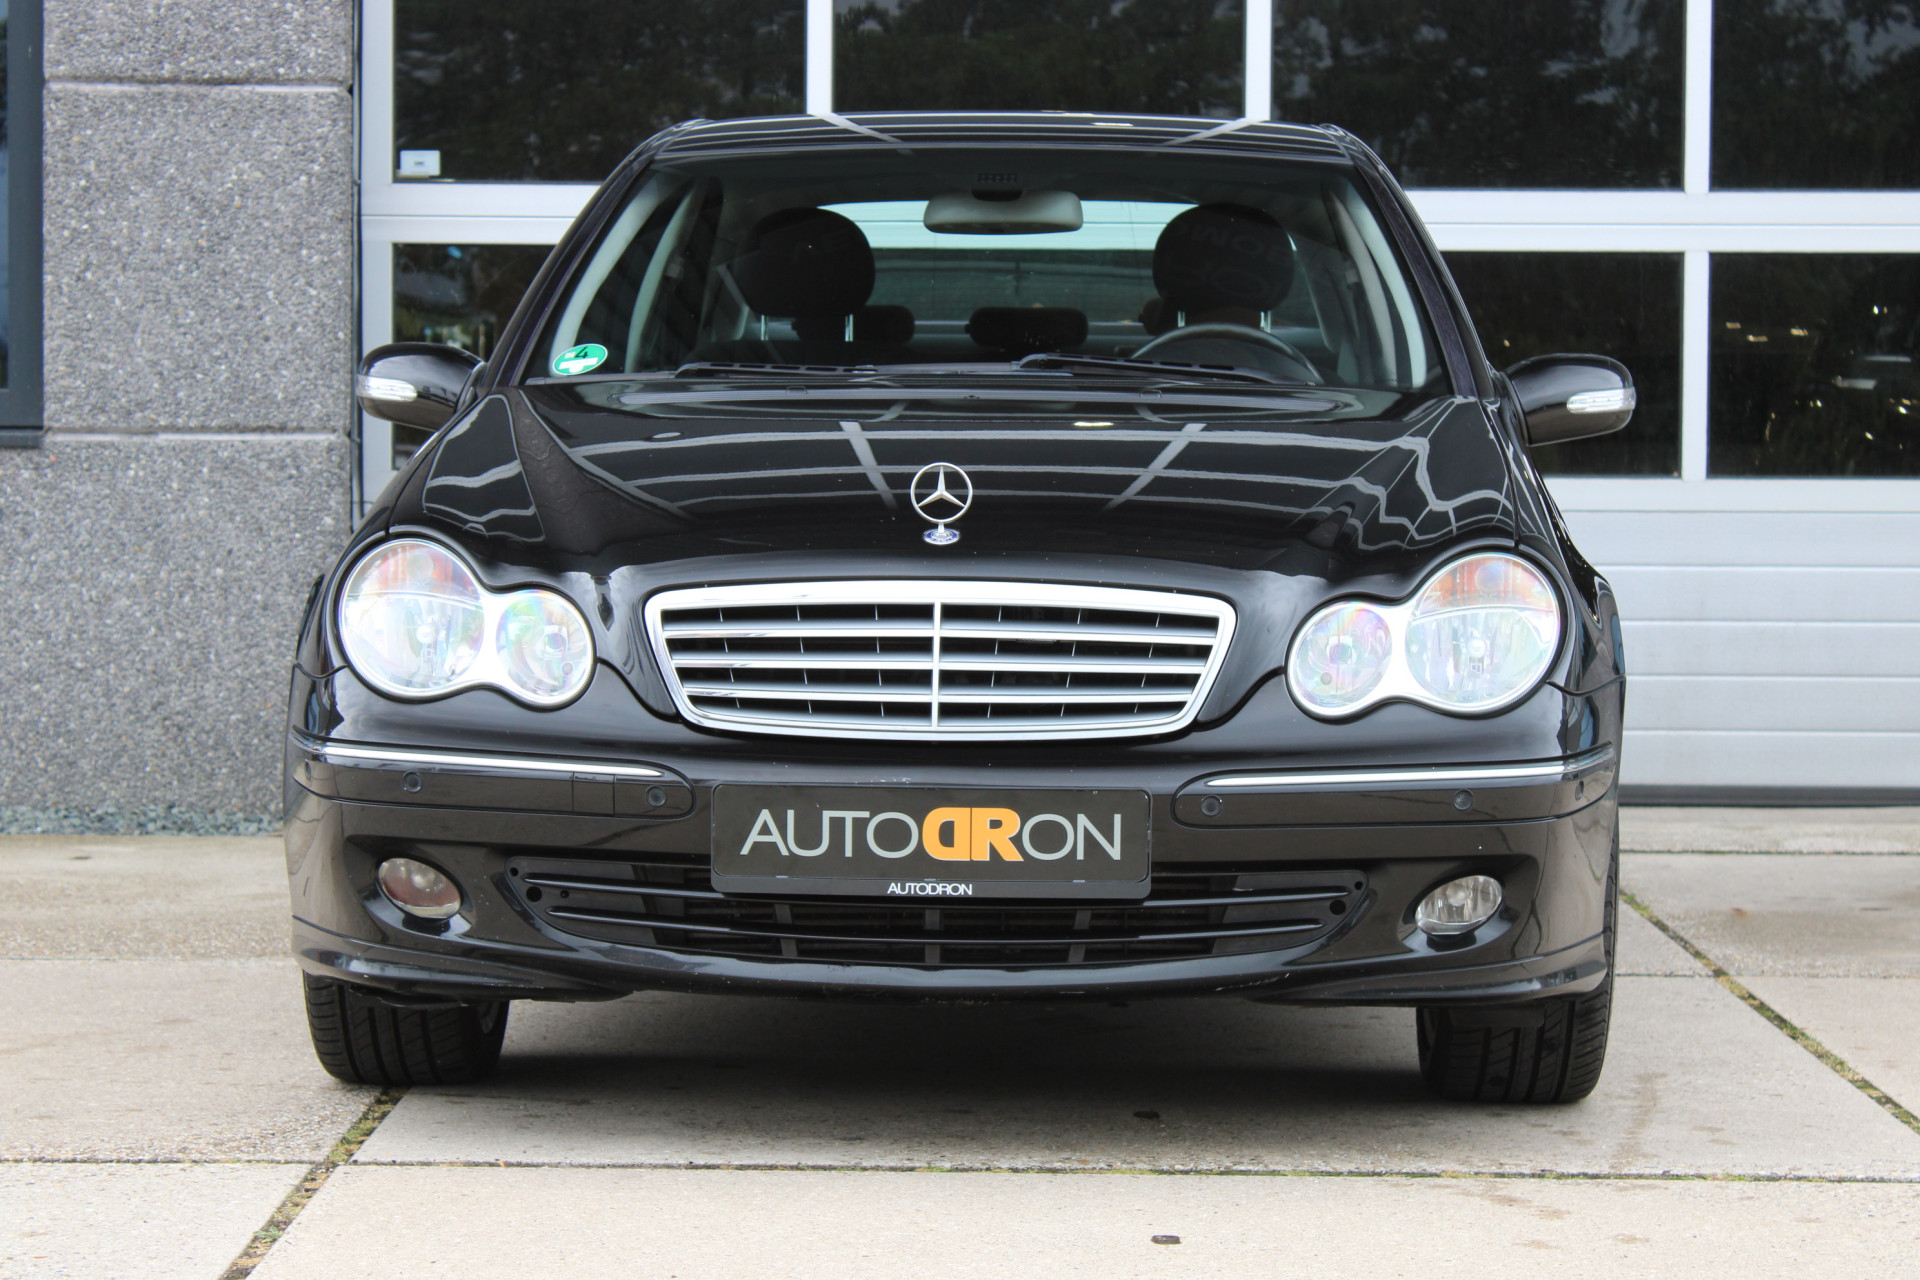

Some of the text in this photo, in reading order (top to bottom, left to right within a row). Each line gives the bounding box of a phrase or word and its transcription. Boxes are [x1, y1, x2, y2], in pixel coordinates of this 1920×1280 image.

[575, 346, 588, 359] 4
[740, 806, 1121, 862] AUTODRON
[887, 882, 973, 896] AUTODRON
